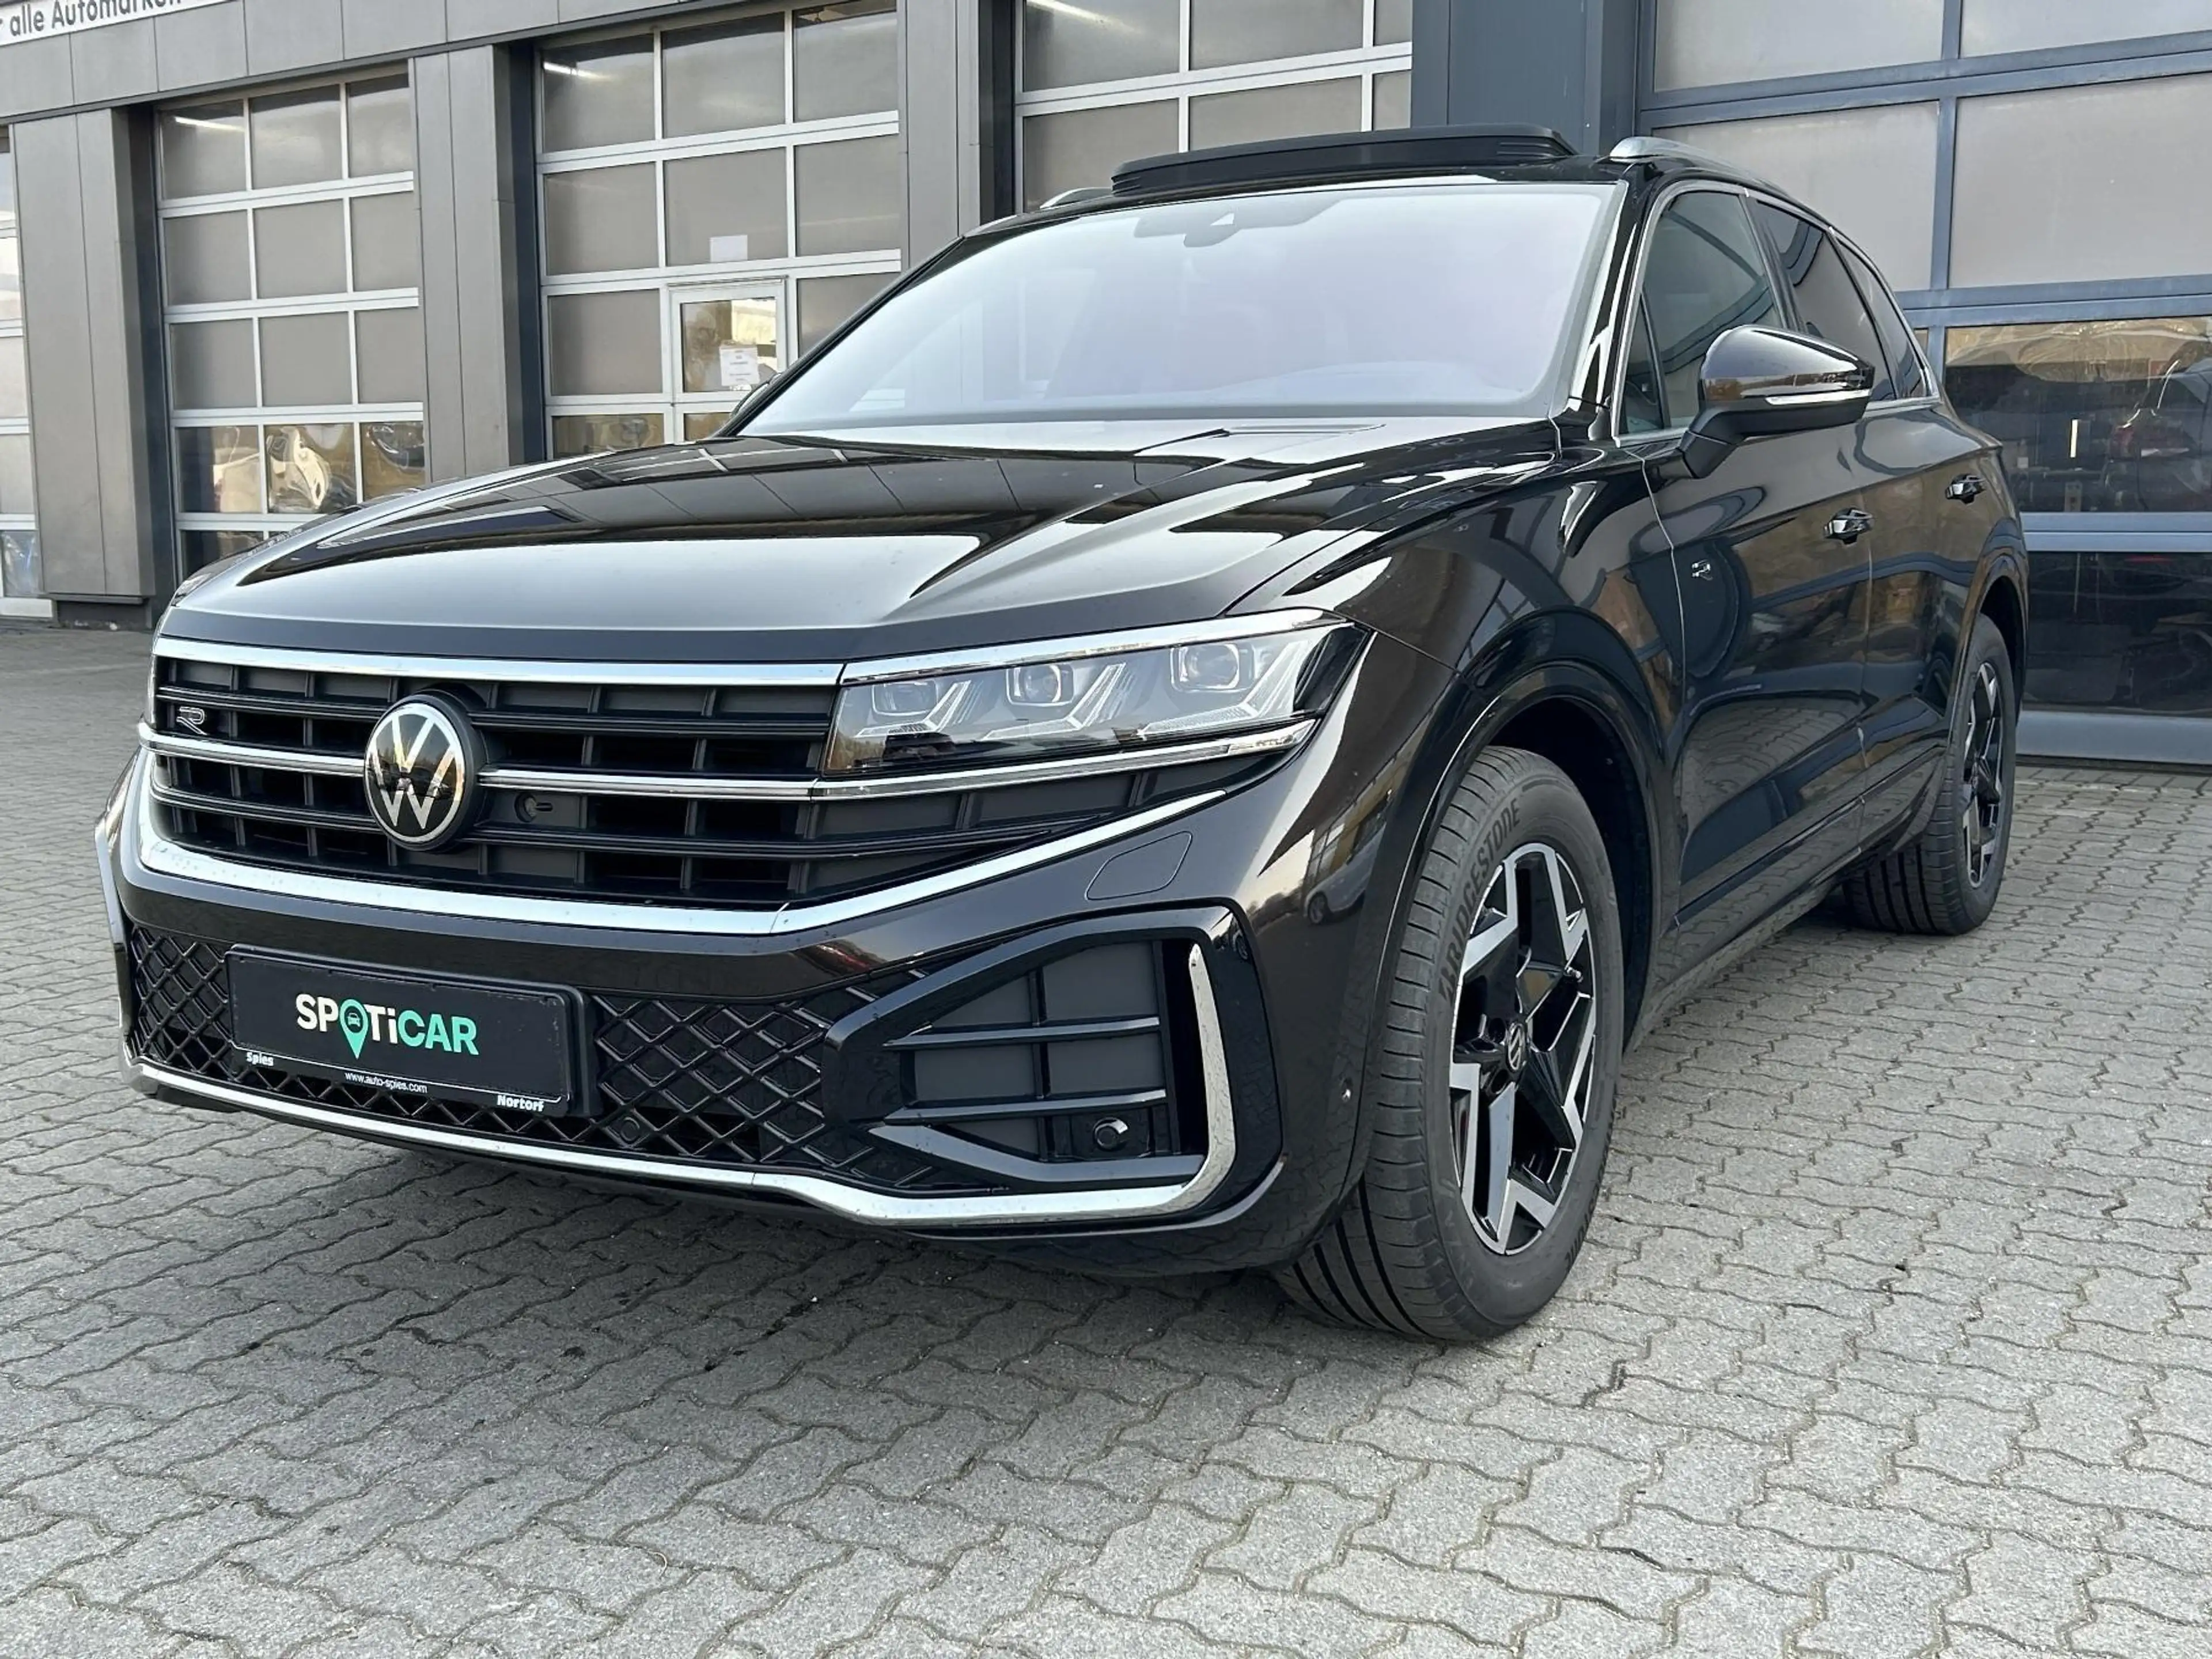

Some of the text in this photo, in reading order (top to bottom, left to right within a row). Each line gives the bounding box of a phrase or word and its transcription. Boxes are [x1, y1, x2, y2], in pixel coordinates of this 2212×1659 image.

[10, 0, 180, 36] alle Automar
[497, 1095, 544, 1112] Nortorf
